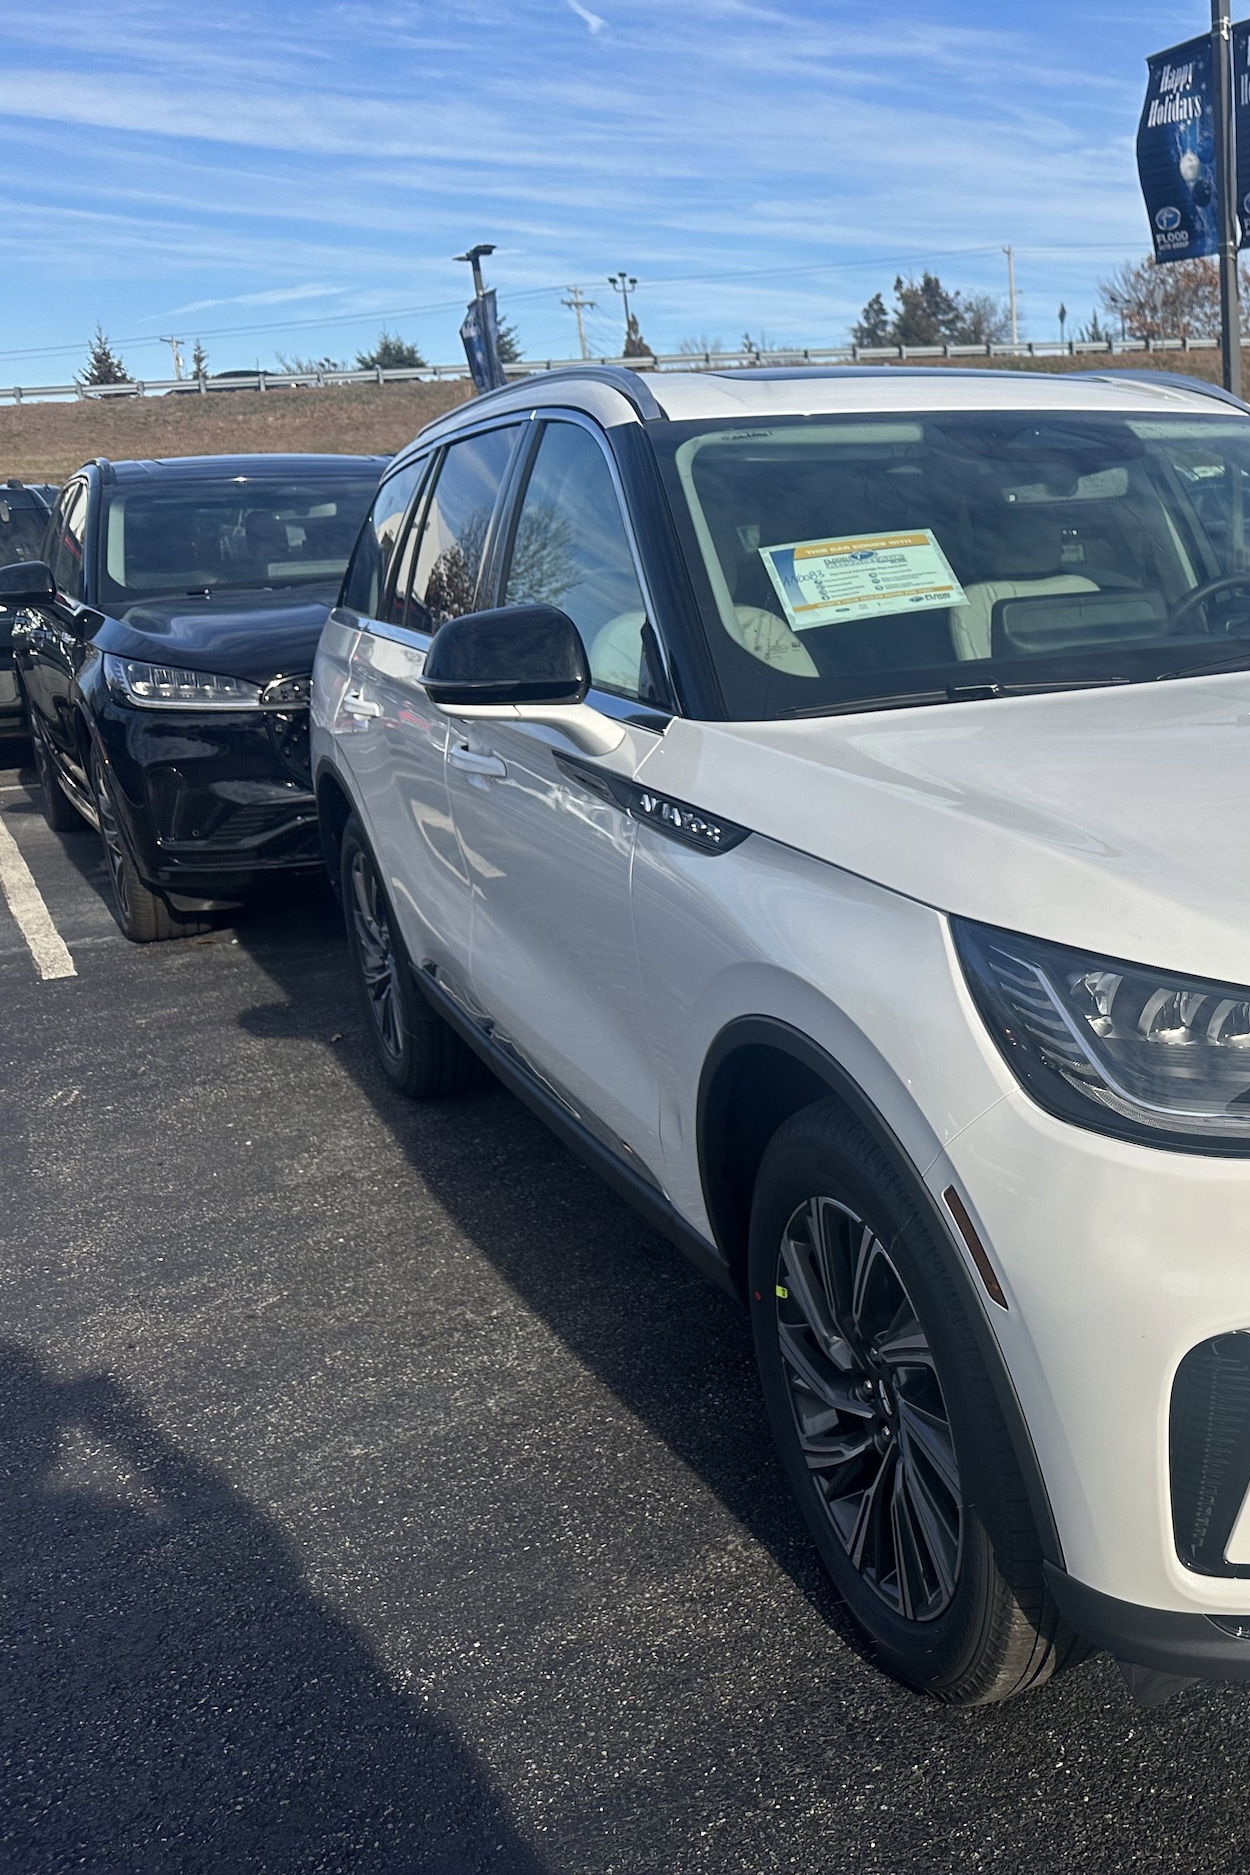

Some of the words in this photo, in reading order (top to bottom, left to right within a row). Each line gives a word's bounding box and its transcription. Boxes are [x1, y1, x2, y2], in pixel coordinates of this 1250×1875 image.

[1160, 62, 1196, 92] Happy
[1148, 94, 1202, 127] Holidays
[1156, 230, 1189, 246] FLOOD
[853, 541, 886, 549] COMES
